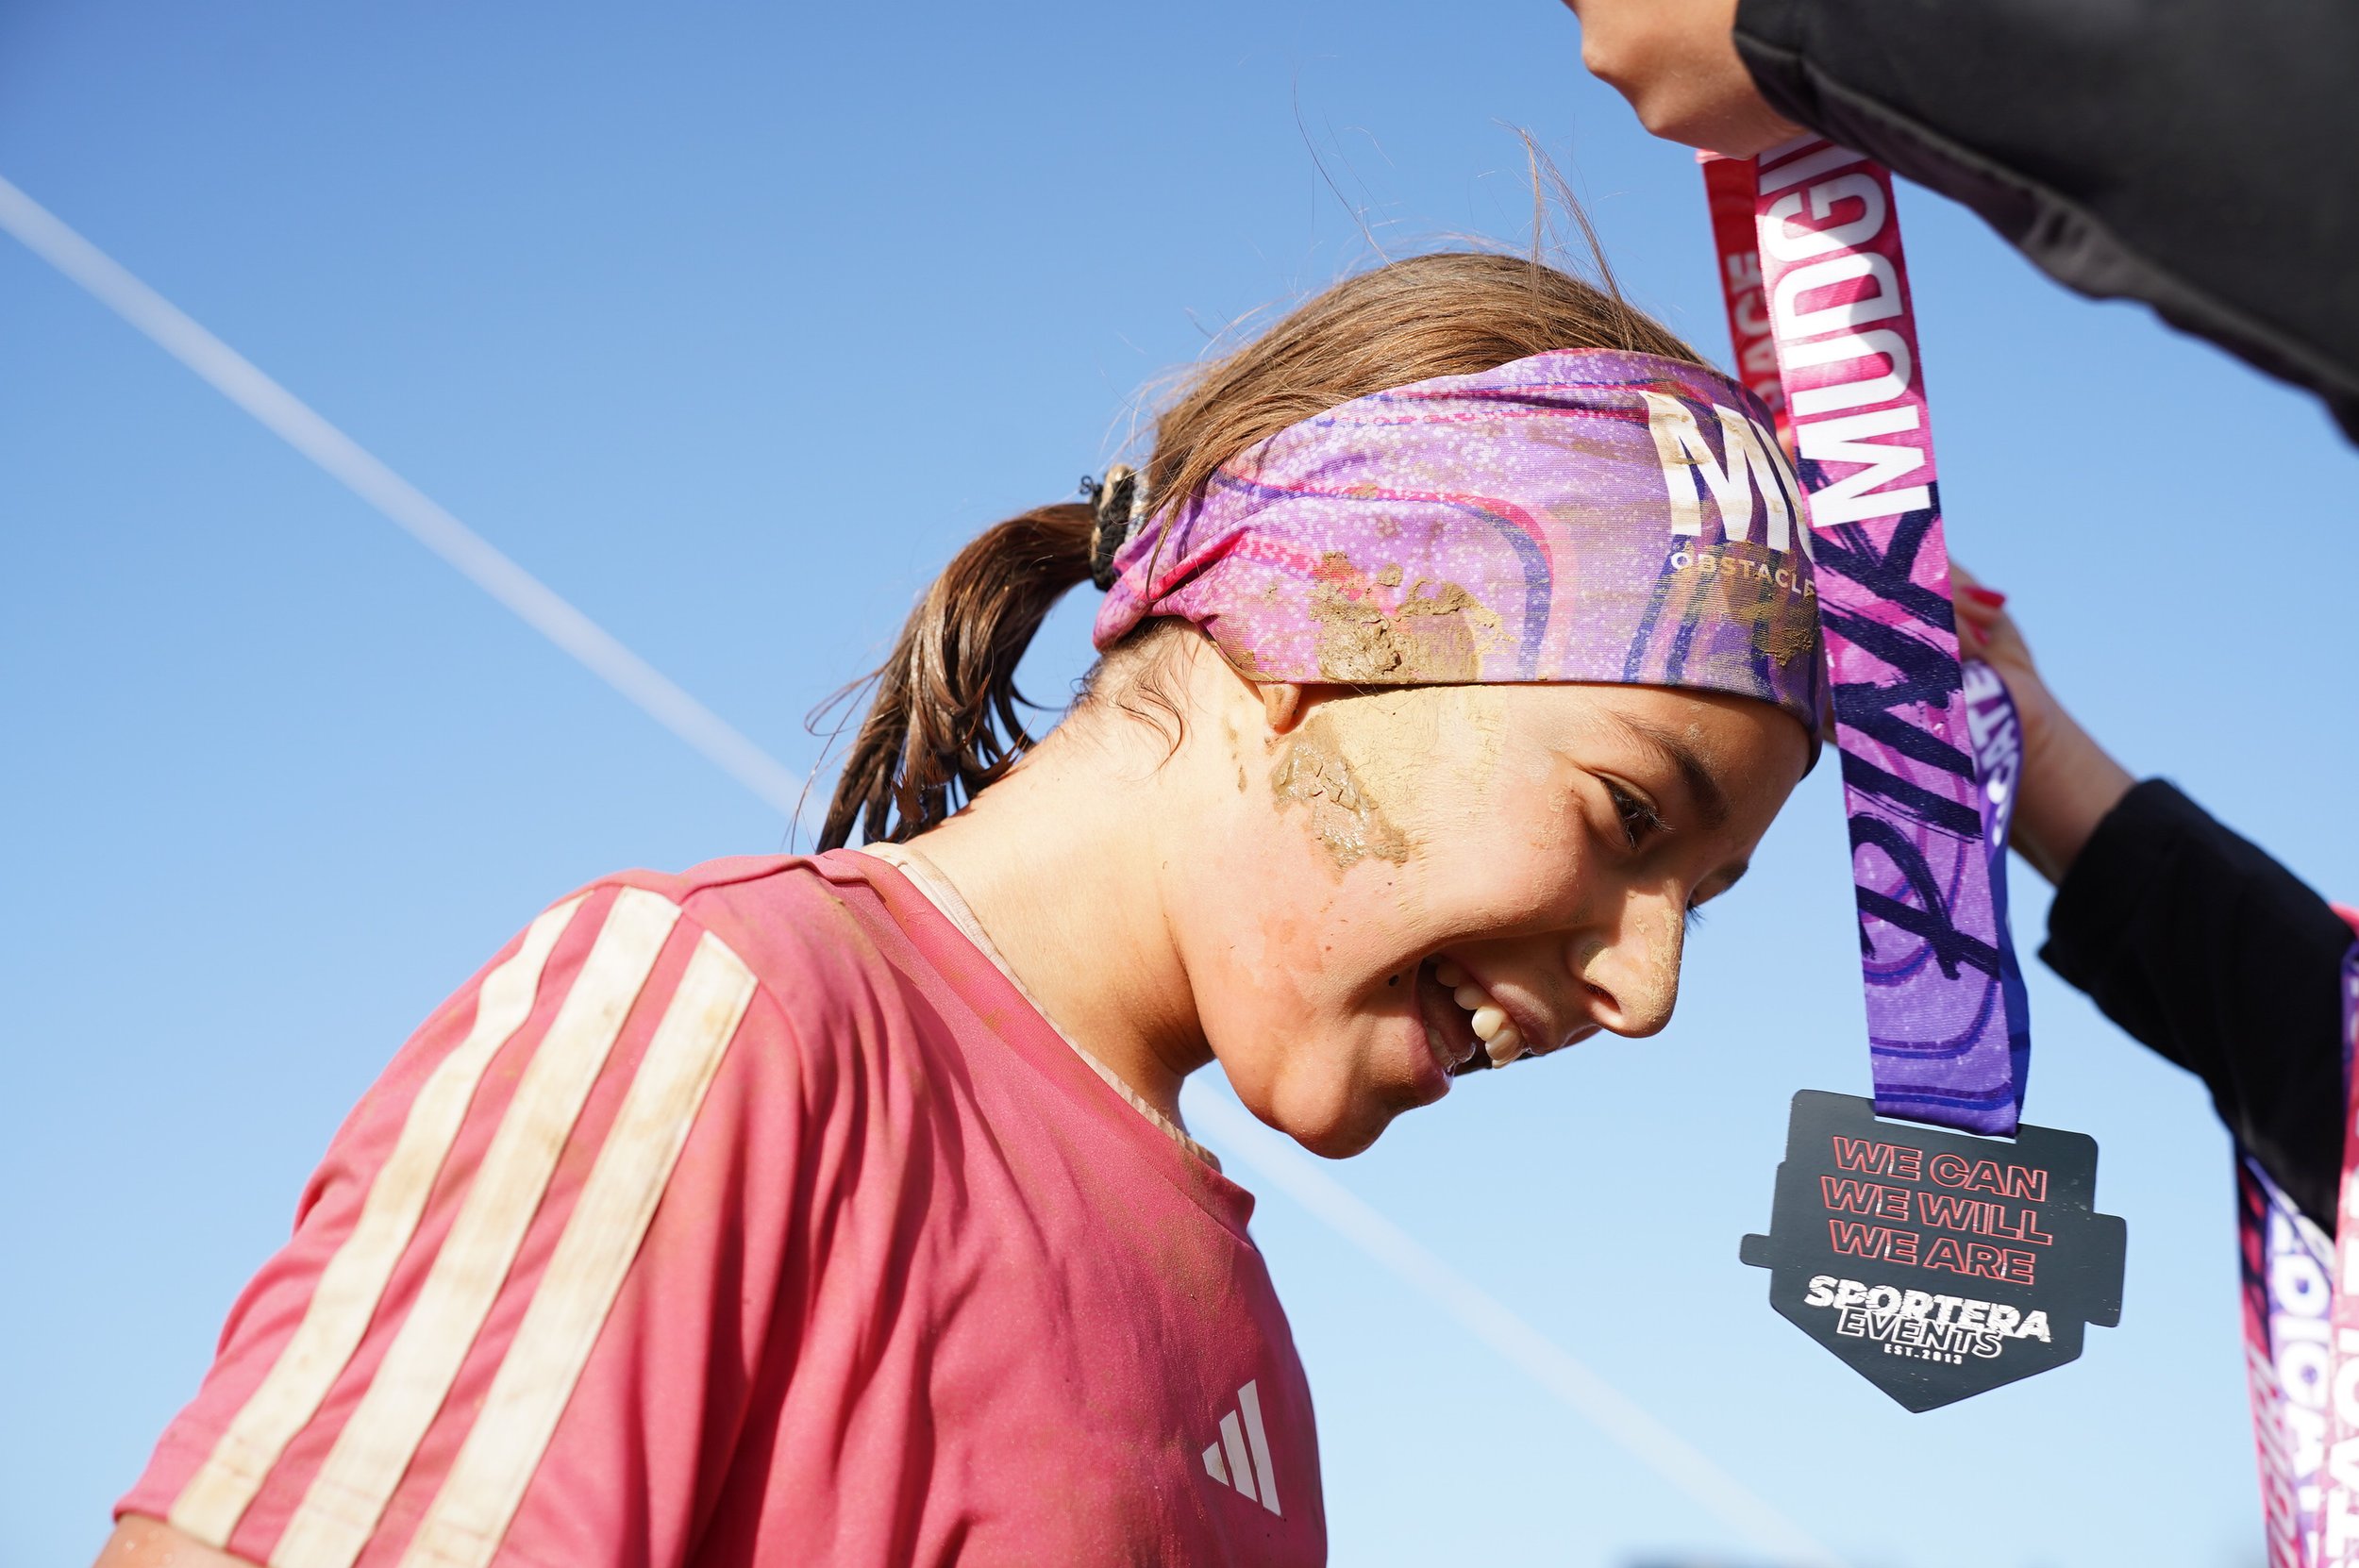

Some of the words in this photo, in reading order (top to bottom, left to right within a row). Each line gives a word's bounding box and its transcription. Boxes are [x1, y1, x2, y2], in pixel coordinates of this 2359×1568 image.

[1759, 133, 1932, 528] MUDGI
[1797, 449, 1999, 982] PINK
[1832, 1135, 1923, 1182] WE
[1929, 1153, 2048, 1203] CAN
[1819, 1176, 1911, 1222] WE
[1917, 1192, 2053, 1246] WILL
[1828, 1219, 1919, 1265] WE
[1923, 1237, 2036, 1285] ARE
[1803, 1275, 2052, 1343] SPORTERA
[1836, 1308, 2002, 1359] EVENTS
